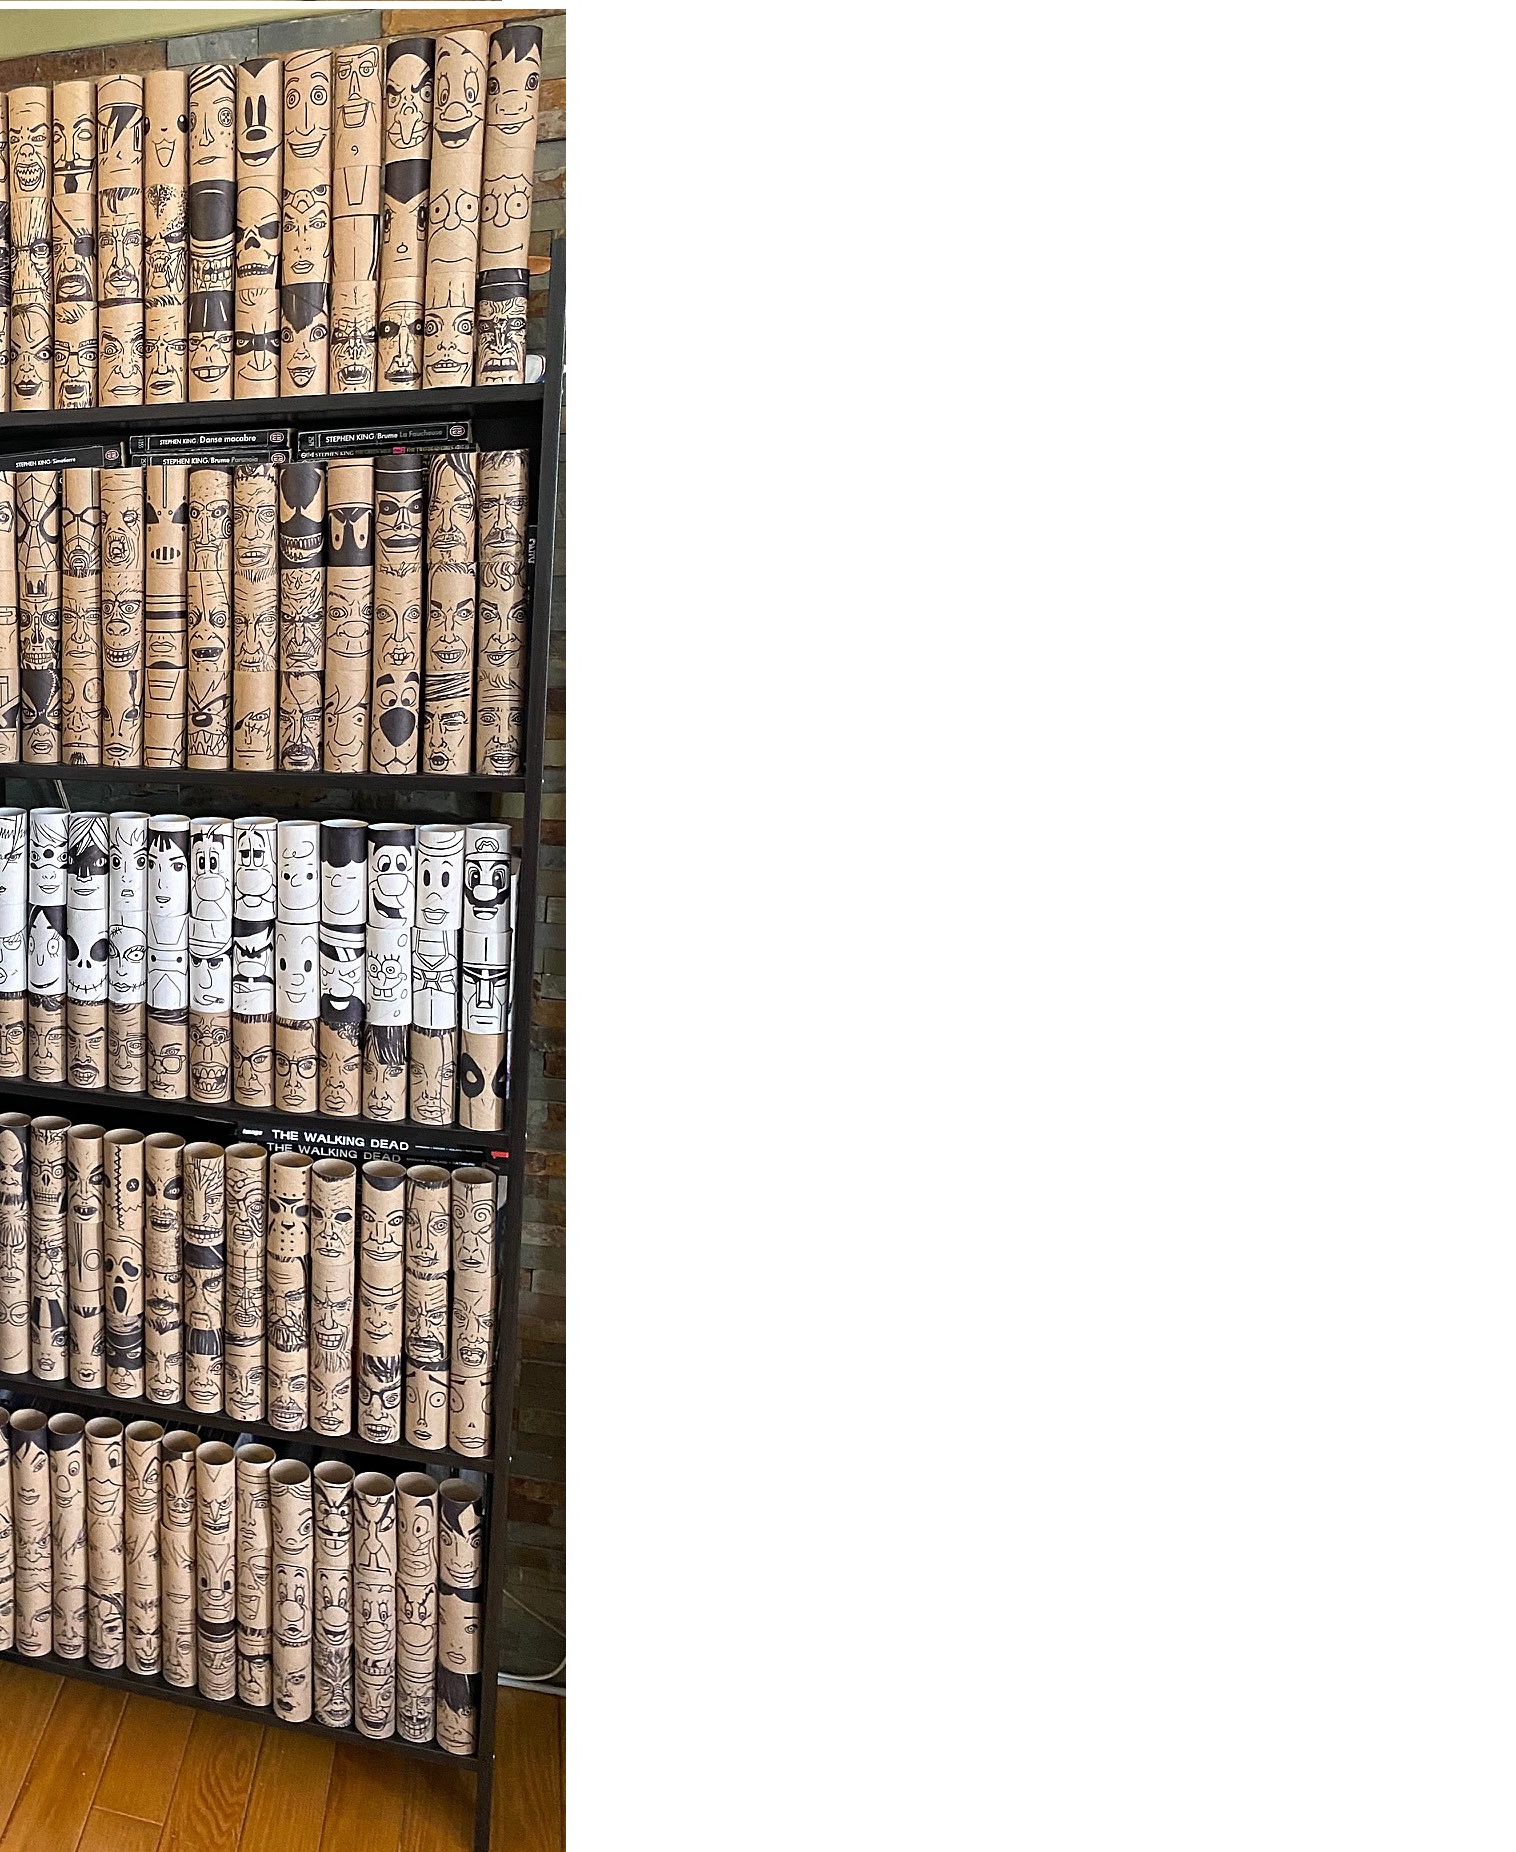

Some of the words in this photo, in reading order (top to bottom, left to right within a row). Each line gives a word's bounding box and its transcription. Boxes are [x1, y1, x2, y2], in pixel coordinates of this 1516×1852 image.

[159, 438, 182, 446] STEPHEN
[199, 435, 223, 444] Danse
[224, 433, 257, 443] macabre
[325, 435, 355, 444] STEPHEN
[15, 460, 37, 468] STEPHEN
[162, 458, 190, 466] STEPHEN
[272, 1129, 299, 1141] THE
[304, 1132, 365, 1148] WALKING
[371, 1138, 410, 1151] DEAD
[266, 1142, 293, 1152] THE
[298, 1144, 358, 1160] WALKING
